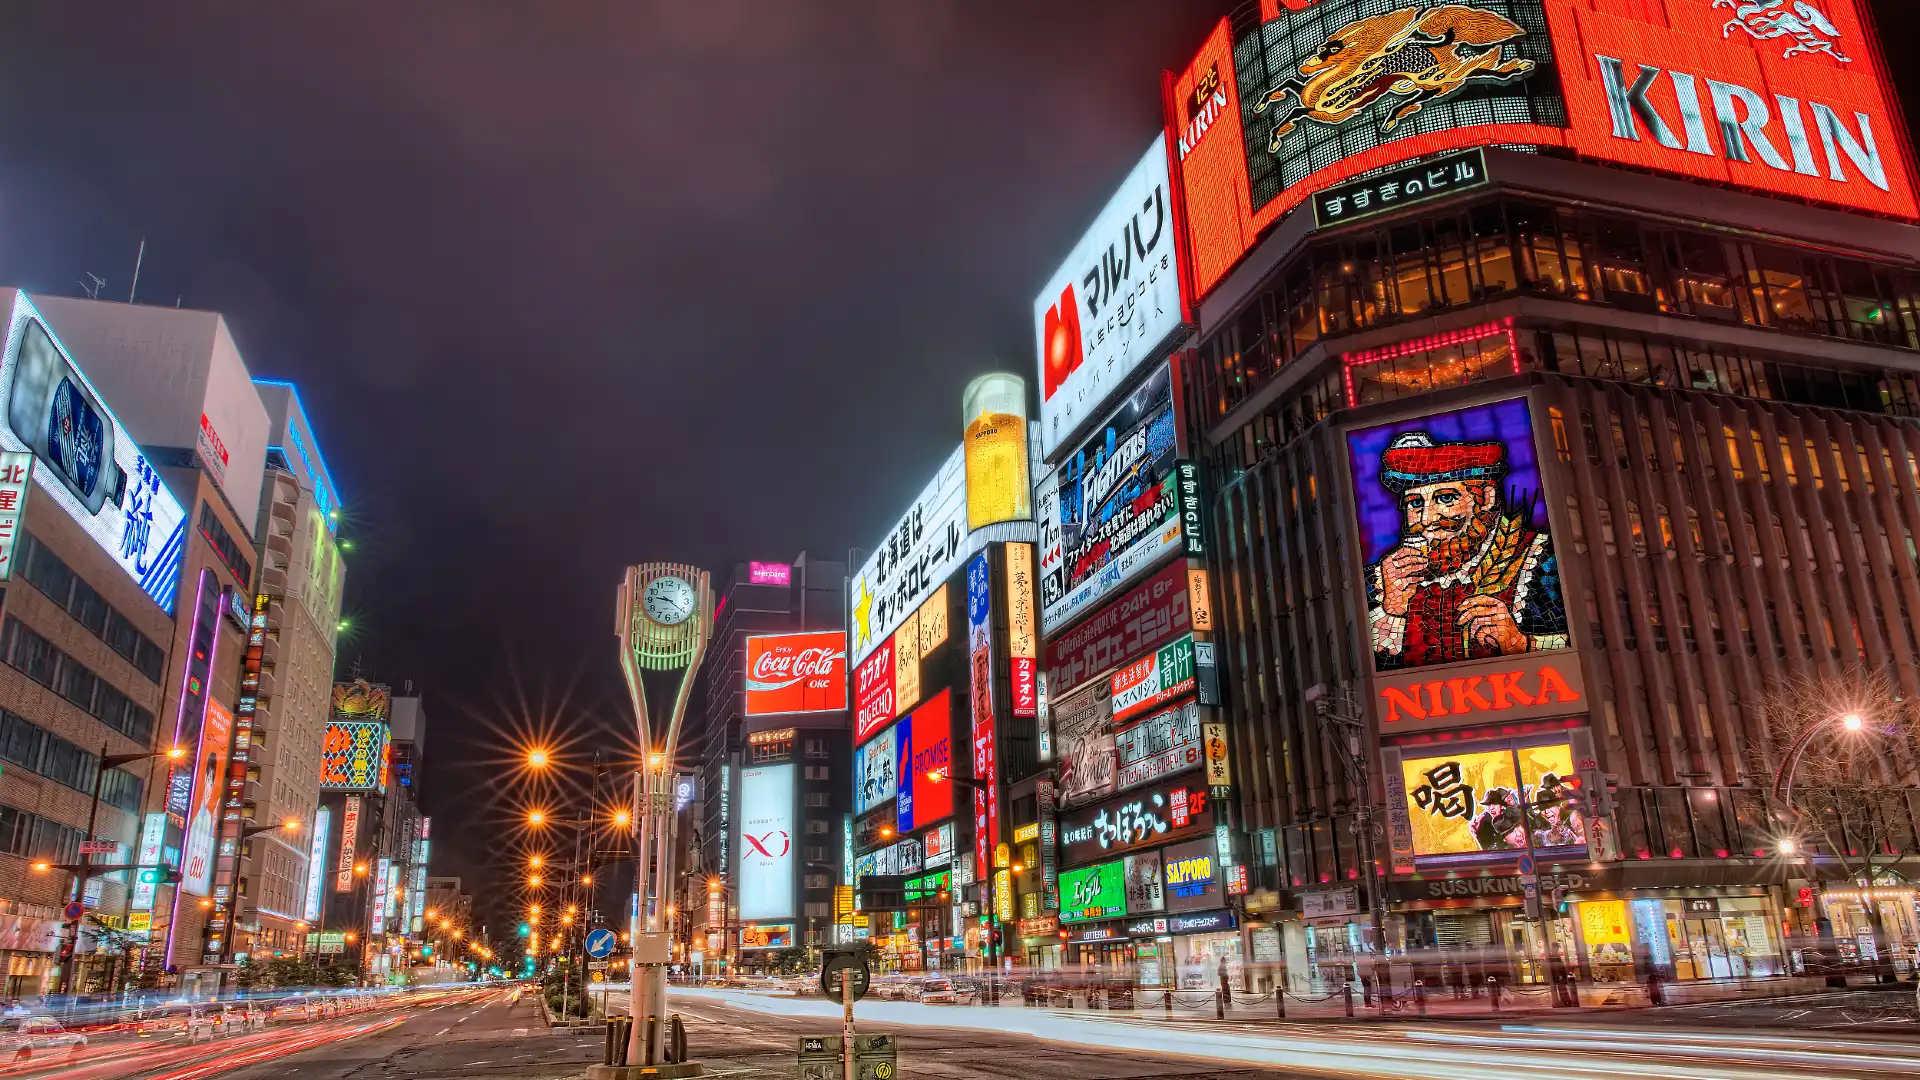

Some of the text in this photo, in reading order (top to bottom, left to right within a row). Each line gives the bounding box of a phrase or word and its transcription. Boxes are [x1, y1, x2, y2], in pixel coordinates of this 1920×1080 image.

[1177, 82, 1229, 161] KIRIN
[1594, 53, 1890, 193] KIRIN
[1325, 160, 1476, 216] すすきのビル
[1084, 184, 1164, 318] マルハン
[1089, 254, 1169, 356] 人生にヨロコビを
[1053, 307, 1164, 430] 新しいパチンコへ
[975, 428, 998, 440] SAPPORO
[1081, 426, 1147, 537] FIGHTERS
[1181, 464, 1203, 552] すすきのビル
[876, 502, 924, 586] 北海道は
[1067, 505, 1134, 566] ファイターズを見ずに
[754, 569, 787, 579] Mercure
[877, 520, 960, 633] サッポロビール
[1120, 593, 1150, 619] 24H
[1153, 578, 1173, 599] 8F
[753, 647, 835, 679] Coca-Cola
[776, 646, 793, 654] Enjoy
[860, 647, 890, 694] カラオケ
[1161, 643, 1193, 687] 青汁
[1018, 658, 1033, 706] カラオケ
[1114, 660, 1150, 691] 新生活習慣
[1114, 679, 1158, 709] ヘスペリジン
[1380, 665, 1581, 722] NIKKA
[858, 687, 893, 737] BIG ECHO
[1039, 702, 1049, 751] グリーンビル
[915, 738, 948, 777] PROMISE
[1189, 791, 1205, 815] 2F
[1211, 786, 1230, 797] 4F
[1387, 775, 1406, 837] 北海道新聞
[1410, 761, 1475, 820] 喝
[1063, 826, 1092, 844] 北の味紀行
[1094, 794, 1167, 848] さっぽろっこ
[189, 855, 205, 880] au
[1073, 876, 1103, 906] エイブル
[1166, 856, 1211, 884] SAPPORO
[1083, 929, 1107, 940] LOTTERIA
